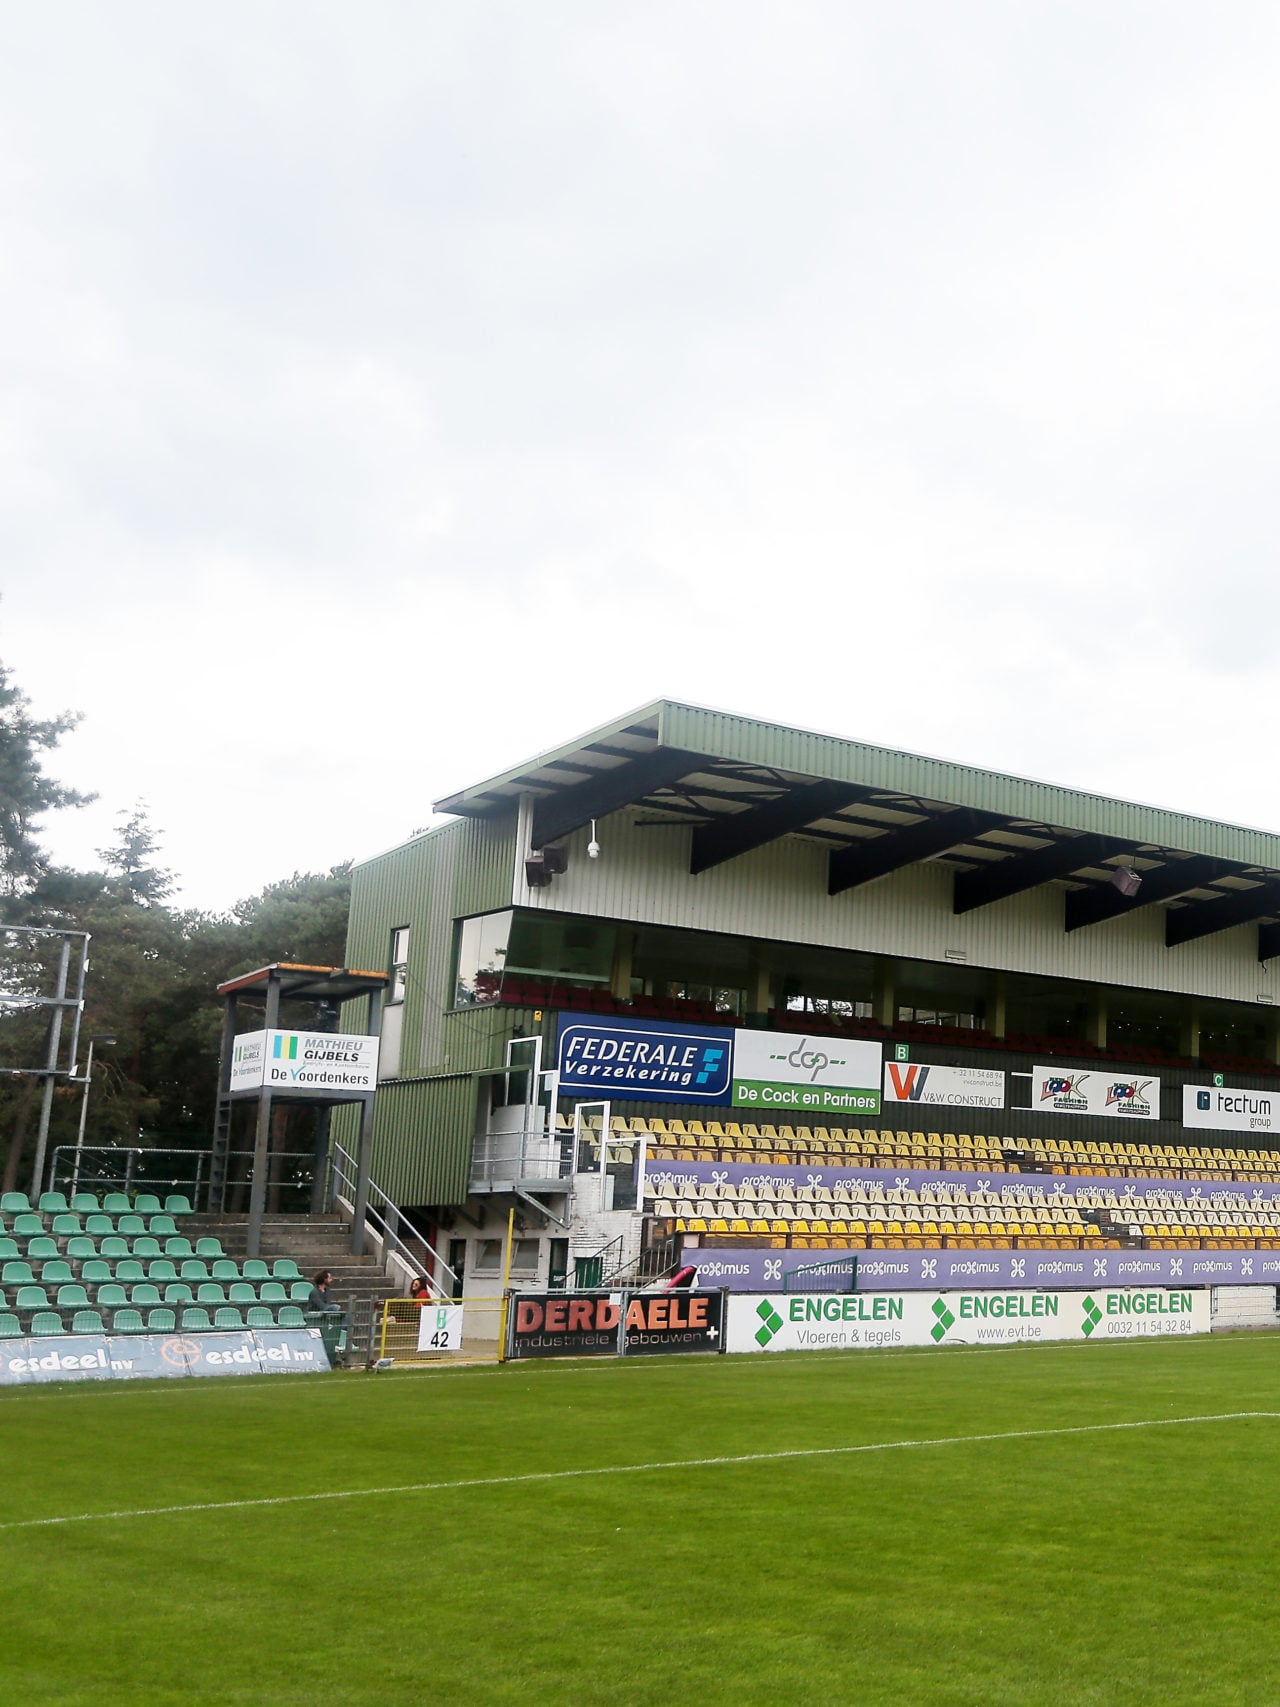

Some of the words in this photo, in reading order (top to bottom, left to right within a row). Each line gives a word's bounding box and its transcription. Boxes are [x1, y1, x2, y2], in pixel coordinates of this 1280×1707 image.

[304, 1038, 364, 1051] MATHIEU
[566, 1036, 698, 1067] FEDERALE
[304, 1050, 360, 1062] GIJBELS
[897, 1046, 906, 1059] B
[271, 1068, 287, 1080] De
[290, 1065, 369, 1085] Voordenkers
[565, 1060, 692, 1086] Verzekering
[1214, 1075, 1222, 1087] C
[738, 1085, 758, 1101] De
[762, 1087, 799, 1104] Cock
[802, 1093, 820, 1105] en
[823, 1092, 876, 1109] Partners
[923, 1093, 945, 1103] V&W
[947, 1094, 1002, 1107] CONSTRUCT
[1217, 1092, 1271, 1115] tectum
[1249, 1117, 1271, 1128] group
[741, 1175, 795, 1187] proximus
[835, 1178, 884, 1189] proximus
[921, 1181, 967, 1192] proximus
[1001, 1183, 1044, 1194] proximus
[1076, 1186, 1116, 1196] proximus
[1145, 1188, 1183, 1199] proximus
[1210, 1190, 1245, 1201] proximus
[692, 1262, 751, 1277] roximus
[857, 1261, 909, 1276] proximus
[950, 1261, 1000, 1275] proximus
[1038, 1260, 1083, 1275] proximus
[1118, 1260, 1161, 1274] proximus
[1193, 1260, 1232, 1273] proximus
[789, 1297, 904, 1322] ENGELEN
[959, 1294, 1058, 1319] ENGELEN
[1106, 1292, 1192, 1315] ENGELEN
[516, 1298, 709, 1333] DERDAELE
[977, 1325, 1041, 1339] www.evt.be
[1107, 1321, 1132, 1334] 0032
[1136, 1321, 1147, 1333] 11
[1150, 1320, 1162, 1333] 54
[1165, 1320, 1177, 1332] 32
[1180, 1319, 1192, 1332] 84
[430, 1331, 449, 1348] 42
[797, 1329, 847, 1344] Vloeren
[850, 1329, 860, 1343] &
[864, 1328, 901, 1346] tegels
[8, 1349, 108, 1372] esdeel
[111, 1359, 134, 1370] nv
[205, 1342, 291, 1365] esdeel
[293, 1350, 314, 1361] nv
